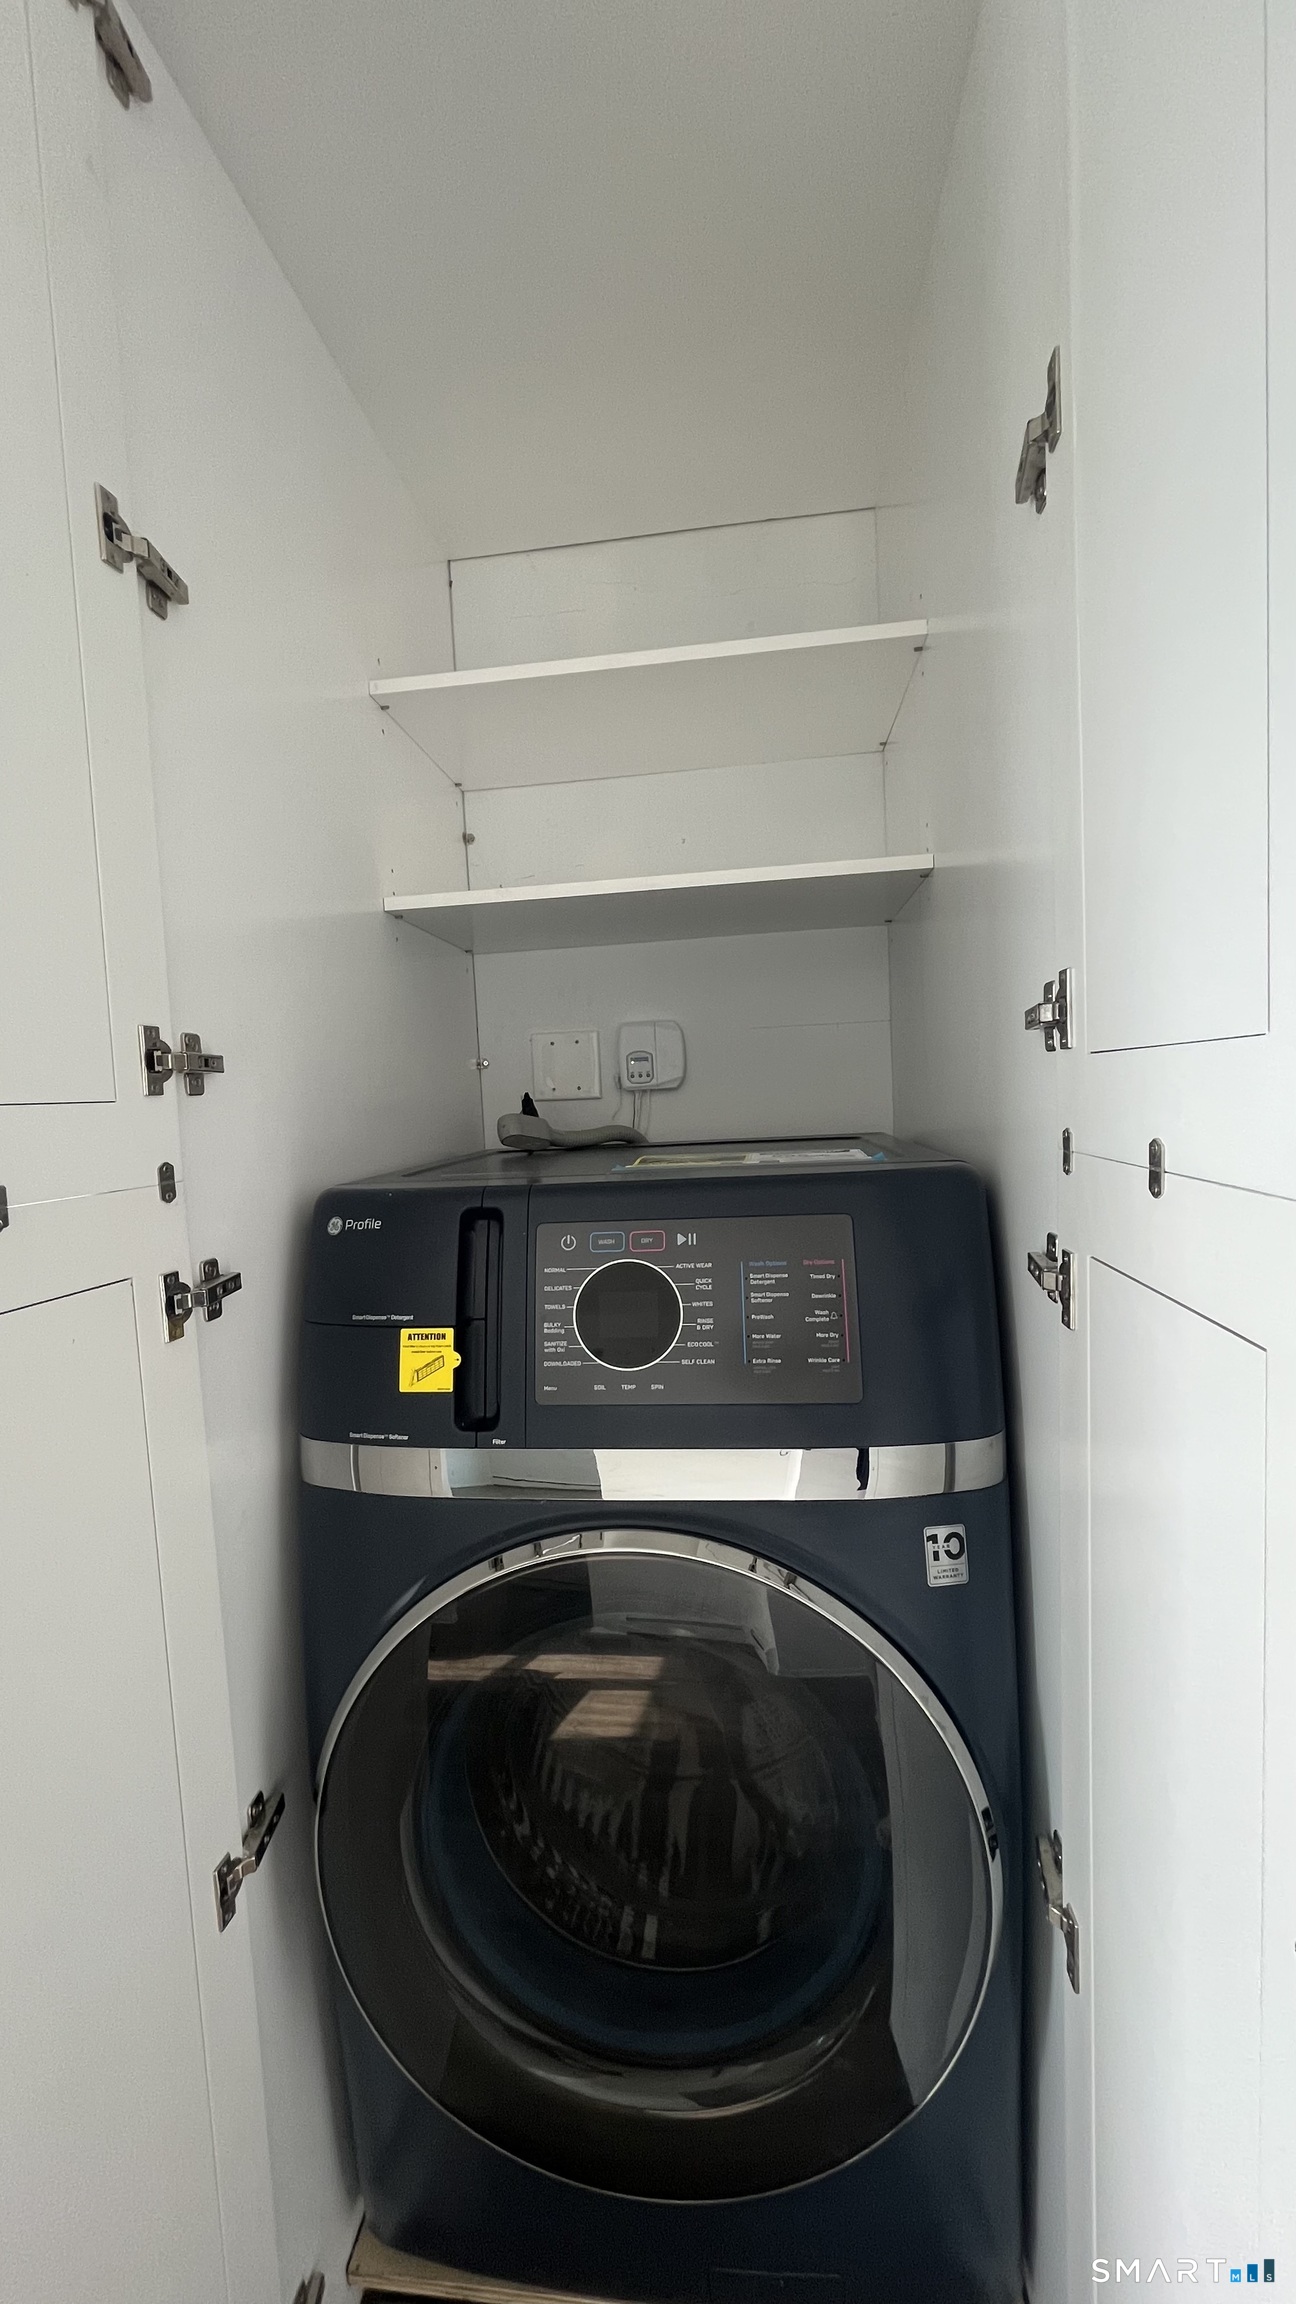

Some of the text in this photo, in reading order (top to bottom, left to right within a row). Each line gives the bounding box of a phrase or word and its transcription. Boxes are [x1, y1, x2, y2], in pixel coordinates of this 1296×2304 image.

[345, 1218, 382, 1230] Profile
[408, 1332, 446, 1341] ATTENTION
[926, 1532, 966, 1562] 10
